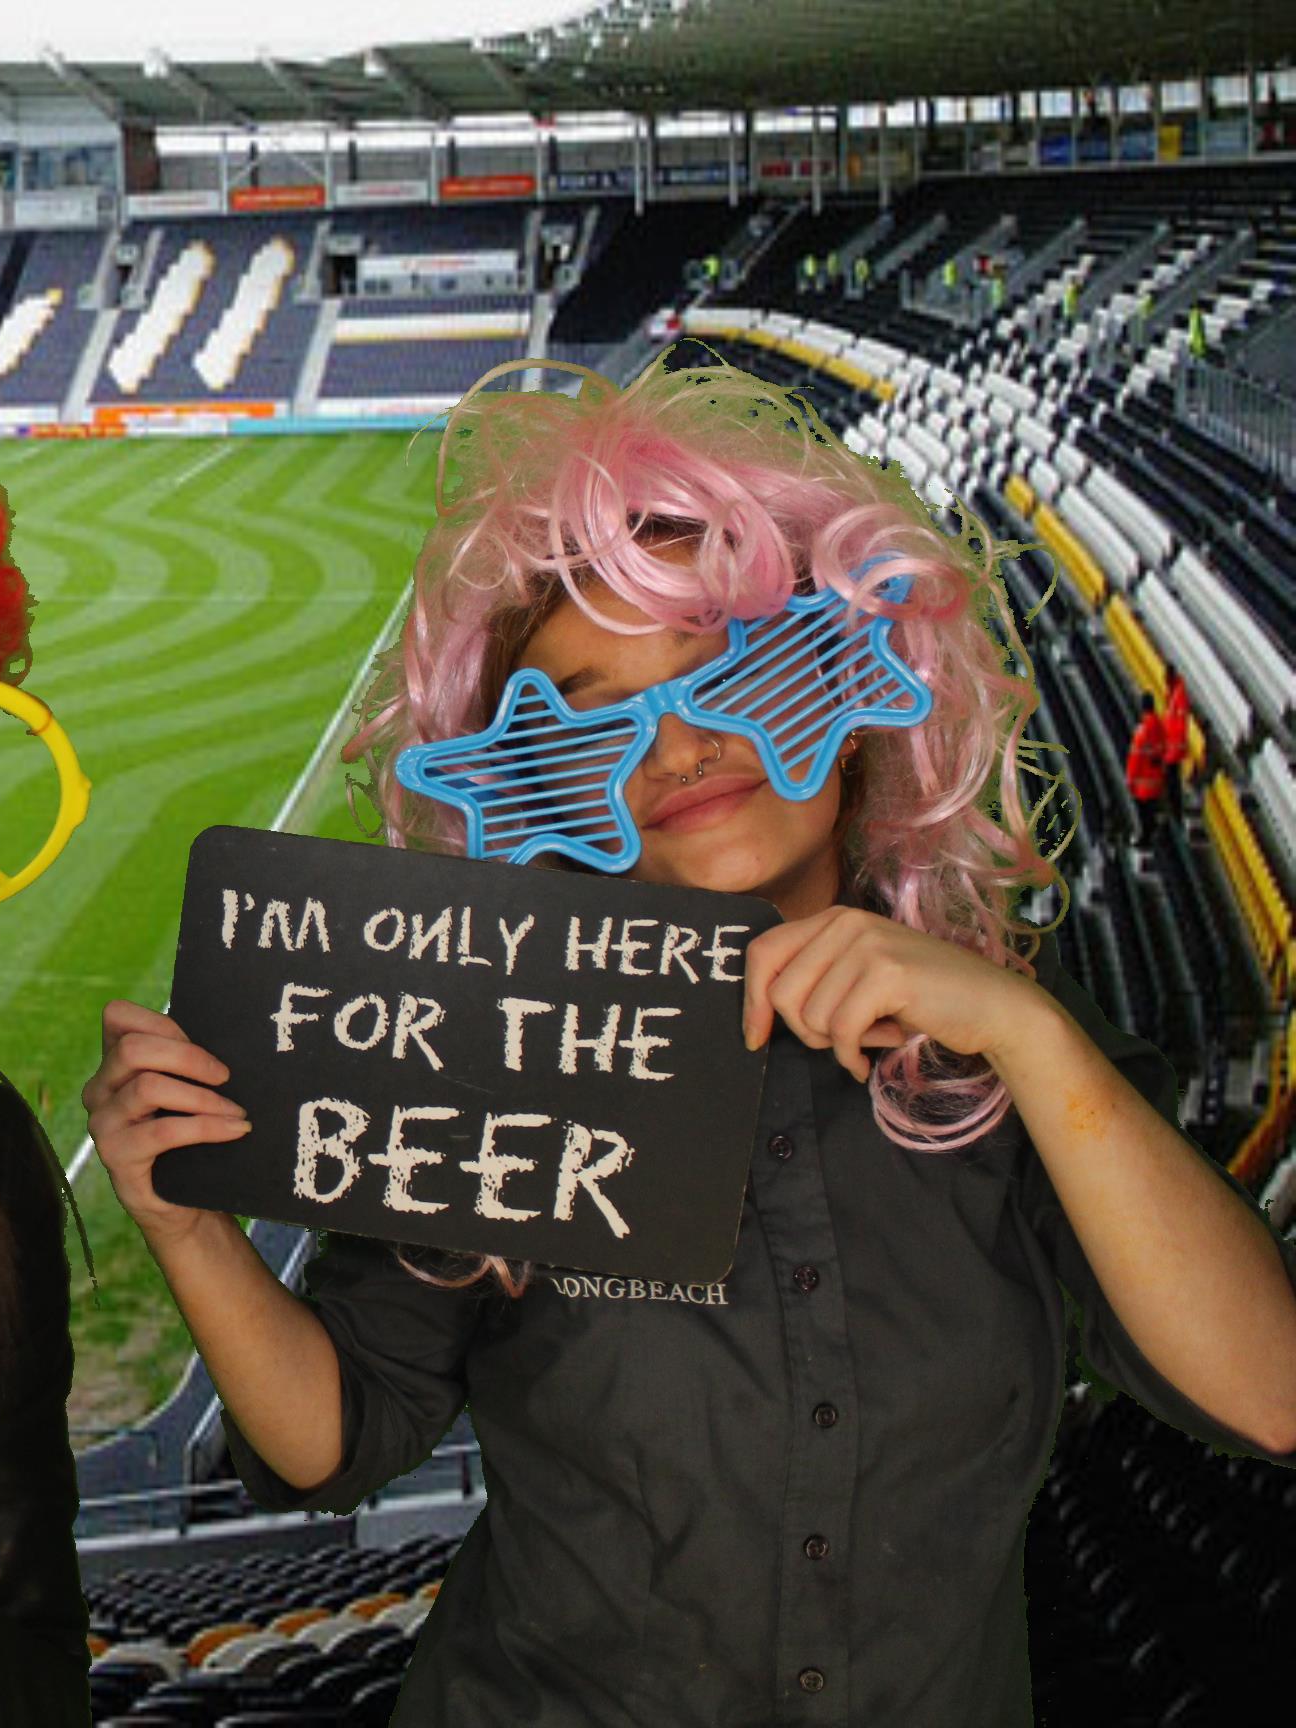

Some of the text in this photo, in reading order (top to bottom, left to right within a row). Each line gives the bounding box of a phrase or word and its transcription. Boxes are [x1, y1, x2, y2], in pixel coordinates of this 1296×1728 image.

[221, 888, 751, 984] I'M ONLY HERE
[269, 982, 682, 1081] FOR THE
[293, 1097, 636, 1239] BEER
